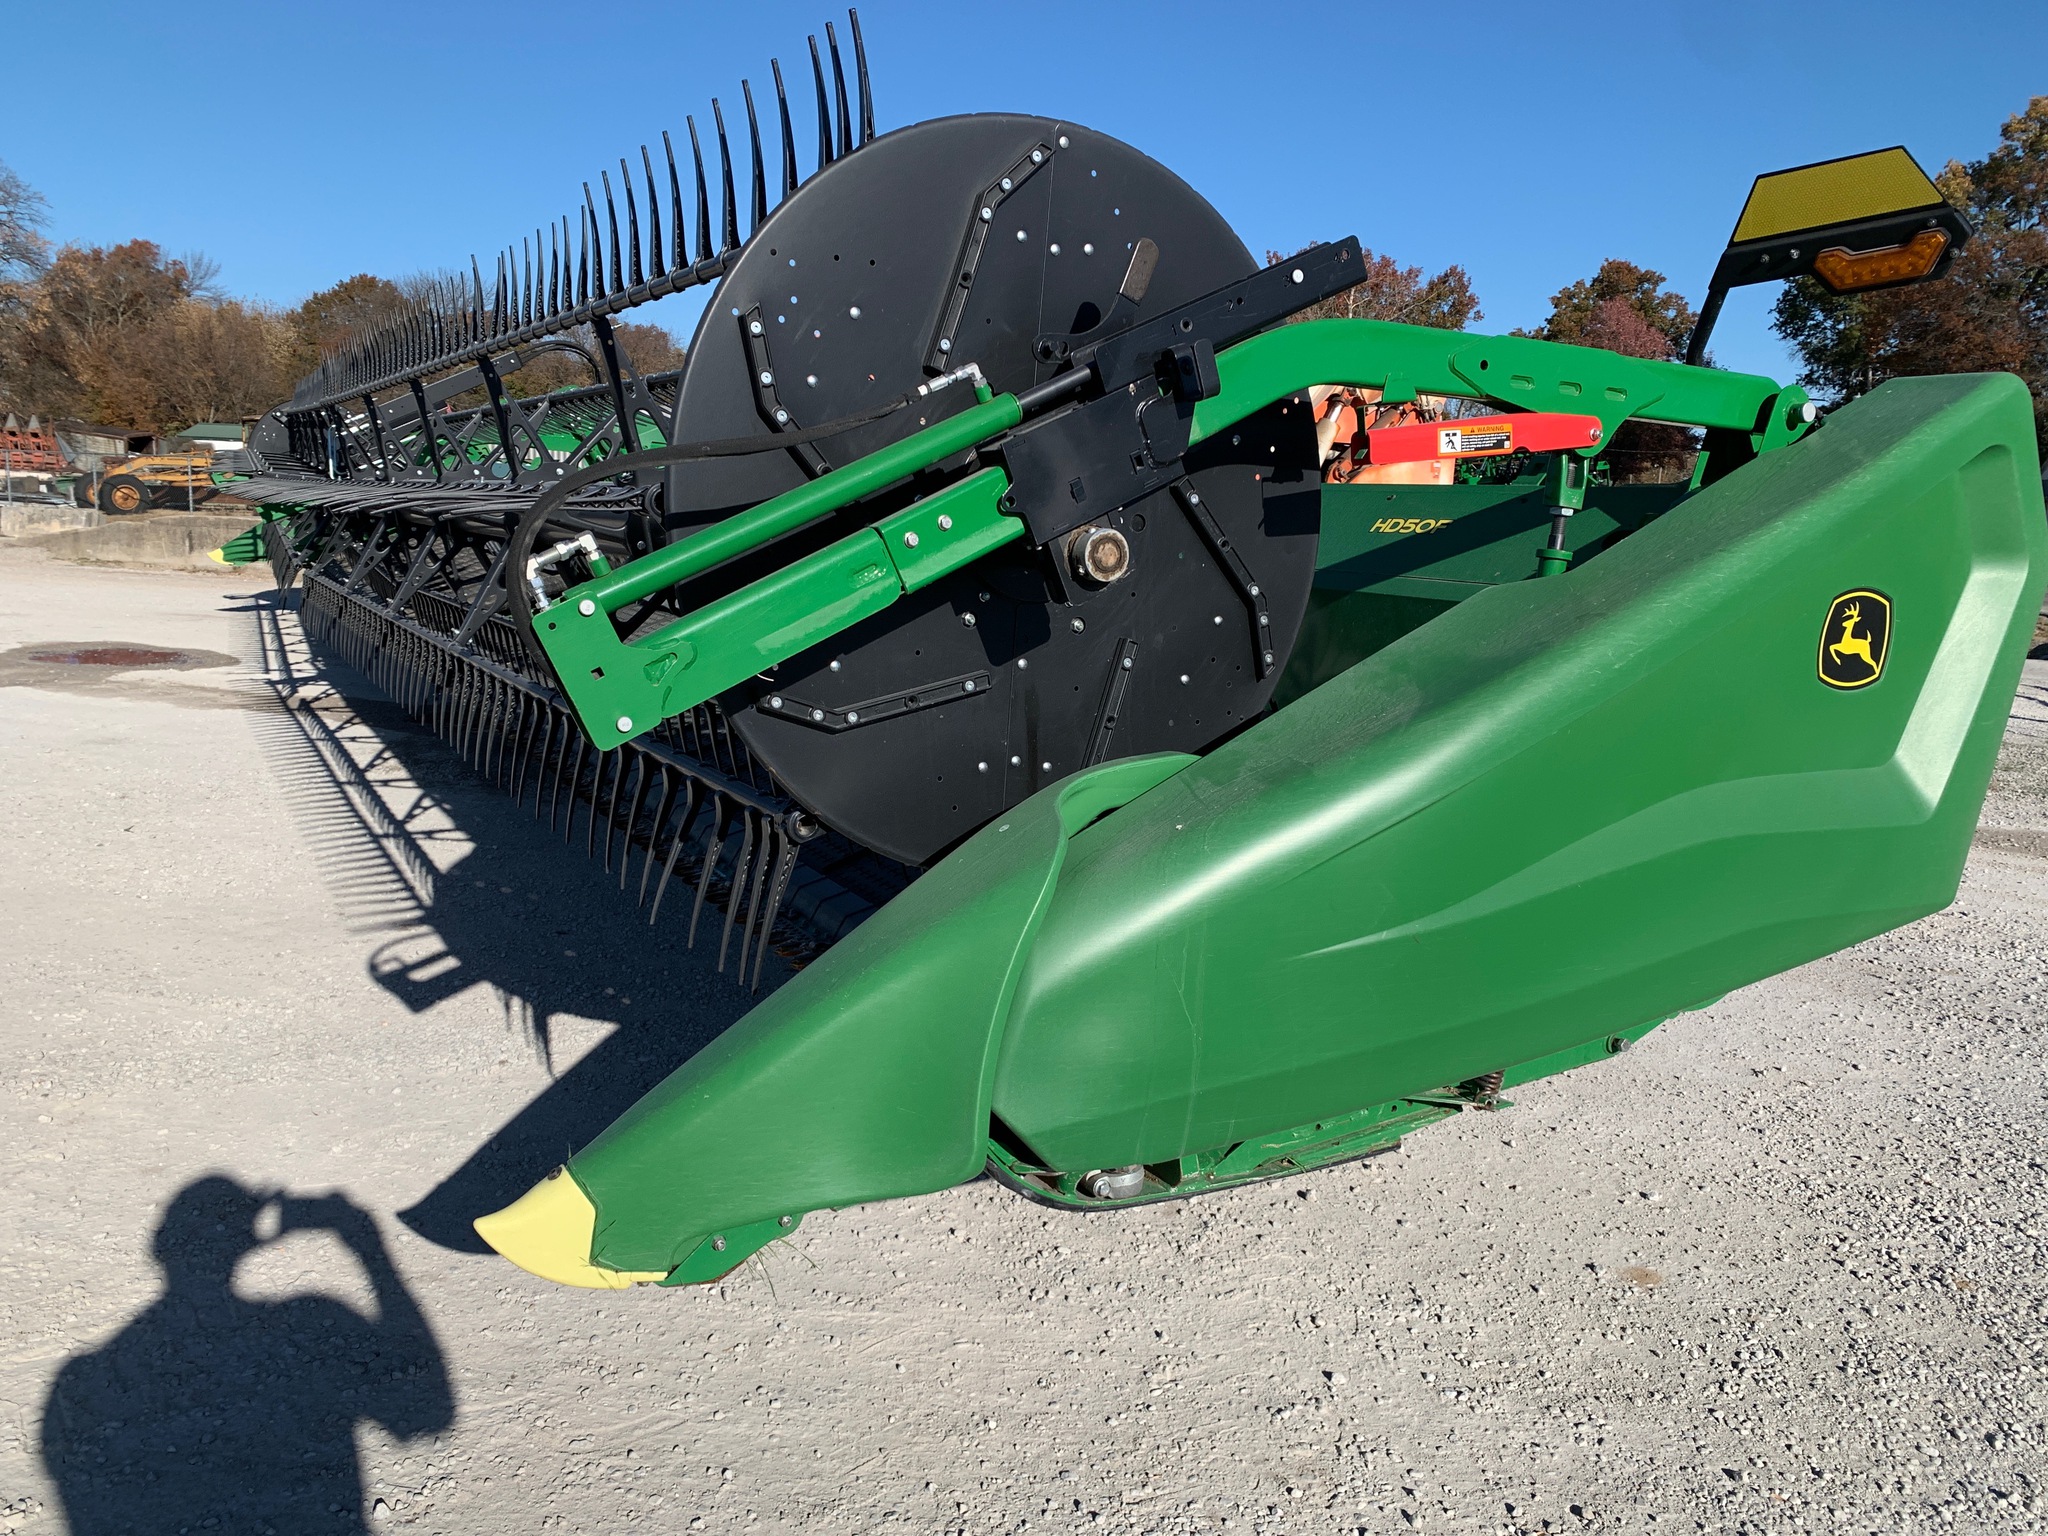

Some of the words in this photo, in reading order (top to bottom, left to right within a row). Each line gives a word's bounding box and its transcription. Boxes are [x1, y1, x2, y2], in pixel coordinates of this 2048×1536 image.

[1282, 274, 1292, 289] 3
[1227, 299, 1236, 313] 2
[1476, 425, 1505, 433] WARNING
[1369, 518, 1454, 534] HD50F
